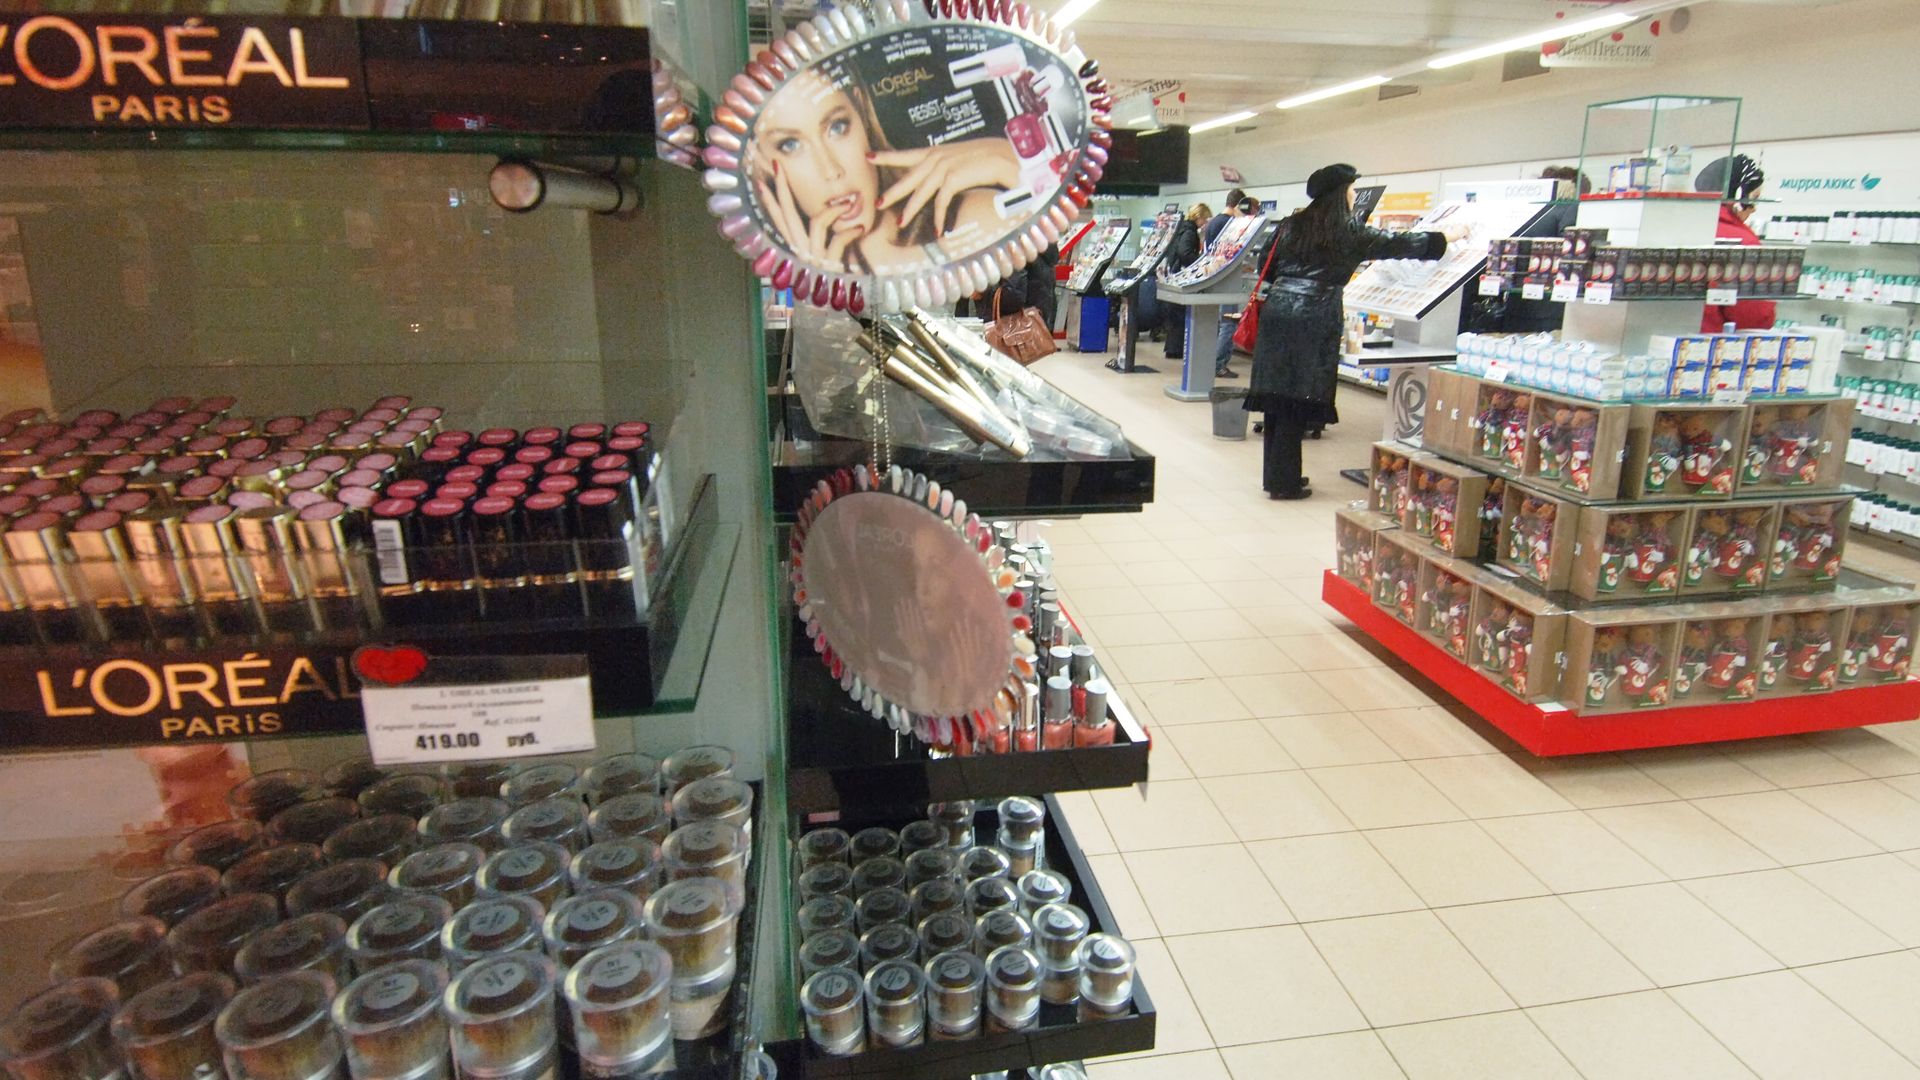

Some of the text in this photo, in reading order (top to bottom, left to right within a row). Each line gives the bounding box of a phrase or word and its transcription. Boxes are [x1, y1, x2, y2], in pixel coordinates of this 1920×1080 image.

[0, 15, 349, 91] 'ORÉAL
[92, 94, 232, 123] PARIS
[908, 98, 940, 123] RESIST
[950, 99, 980, 122] SHINE
[1779, 178, 1856, 192] мирра люкс
[37, 652, 360, 717] L'ORÉAL
[160, 711, 281, 738] PARIS
[416, 733, 540, 749] 419.00 руб.
